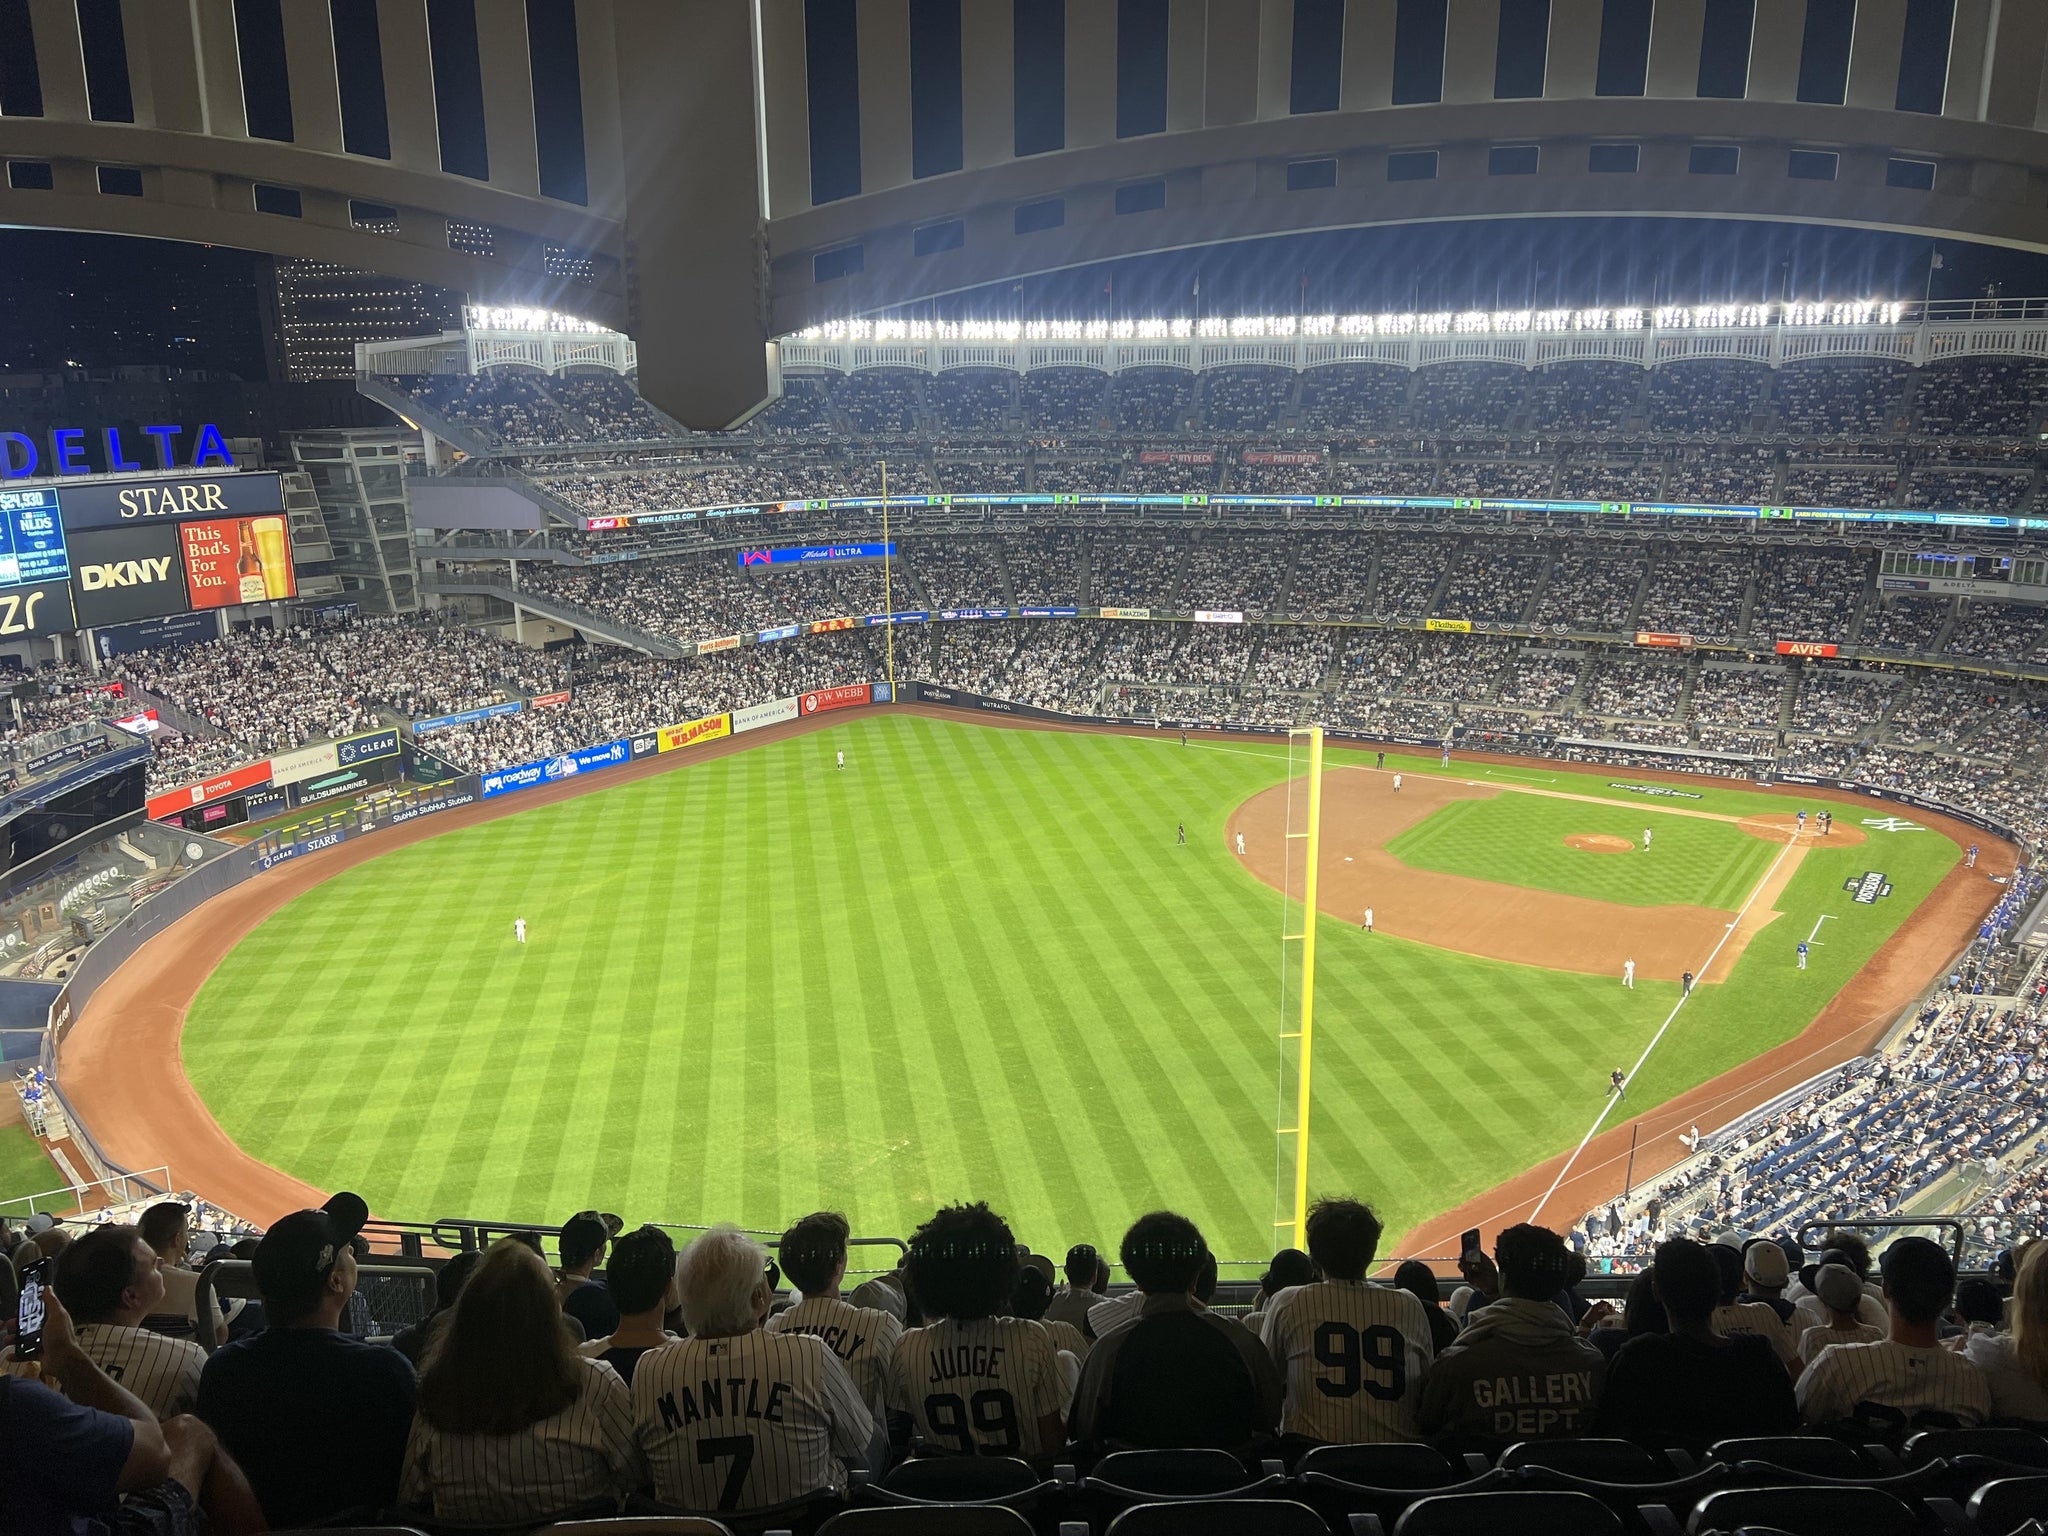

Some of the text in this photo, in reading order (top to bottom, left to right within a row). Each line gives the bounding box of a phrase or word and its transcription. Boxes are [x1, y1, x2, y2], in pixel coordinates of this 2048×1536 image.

[0, 424, 234, 479] DELTA
[1193, 454, 1212, 463] DECK
[1273, 454, 1296, 463] PARTY
[119, 484, 228, 518] STARR
[20, 517, 53, 531] NLDS
[637, 513, 696, 524] WWW.LOBELS.COM
[185, 526, 221, 542] This
[188, 541, 231, 557] Bud's
[835, 548, 862, 556] ULTRA
[190, 558, 217, 573] For
[80, 557, 171, 591] DKNY
[192, 574, 227, 588] You.
[700, 637, 738, 652] Parts Authority
[1789, 644, 1822, 655] AVIS
[836, 687, 864, 698] WEBB
[982, 701, 1011, 711] NUTRAFOL
[735, 716, 751, 726] BANK
[760, 708, 785, 719] AMERICA
[361, 739, 394, 753] CLEAR
[1394, 737, 1421, 745] Booking.com
[274, 766, 288, 774] BANK
[298, 758, 322, 768] AMERICA
[579, 756, 591, 766] We
[592, 752, 610, 763] move
[503, 767, 541, 784] roadway
[1783, 775, 1818, 783] Booking.com
[206, 780, 232, 794] TOYOTA
[300, 779, 368, 804] BUILDSUBMARINES
[419, 802, 446, 815] StubHub
[448, 795, 473, 808] StubHub
[393, 809, 418, 823] StubHub
[307, 834, 338, 851] STARR
[273, 850, 292, 862] CLEAR
[1855, 872, 1884, 903] POSTSEASON
[929, 1345, 1006, 1383] JUDGE
[1314, 1321, 1406, 1401] 99
[1473, 1372, 1594, 1408] GALLERY
[657, 1377, 792, 1433] MANTLE
[924, 1388, 1021, 1456] 99
[696, 1434, 755, 1512] 7
